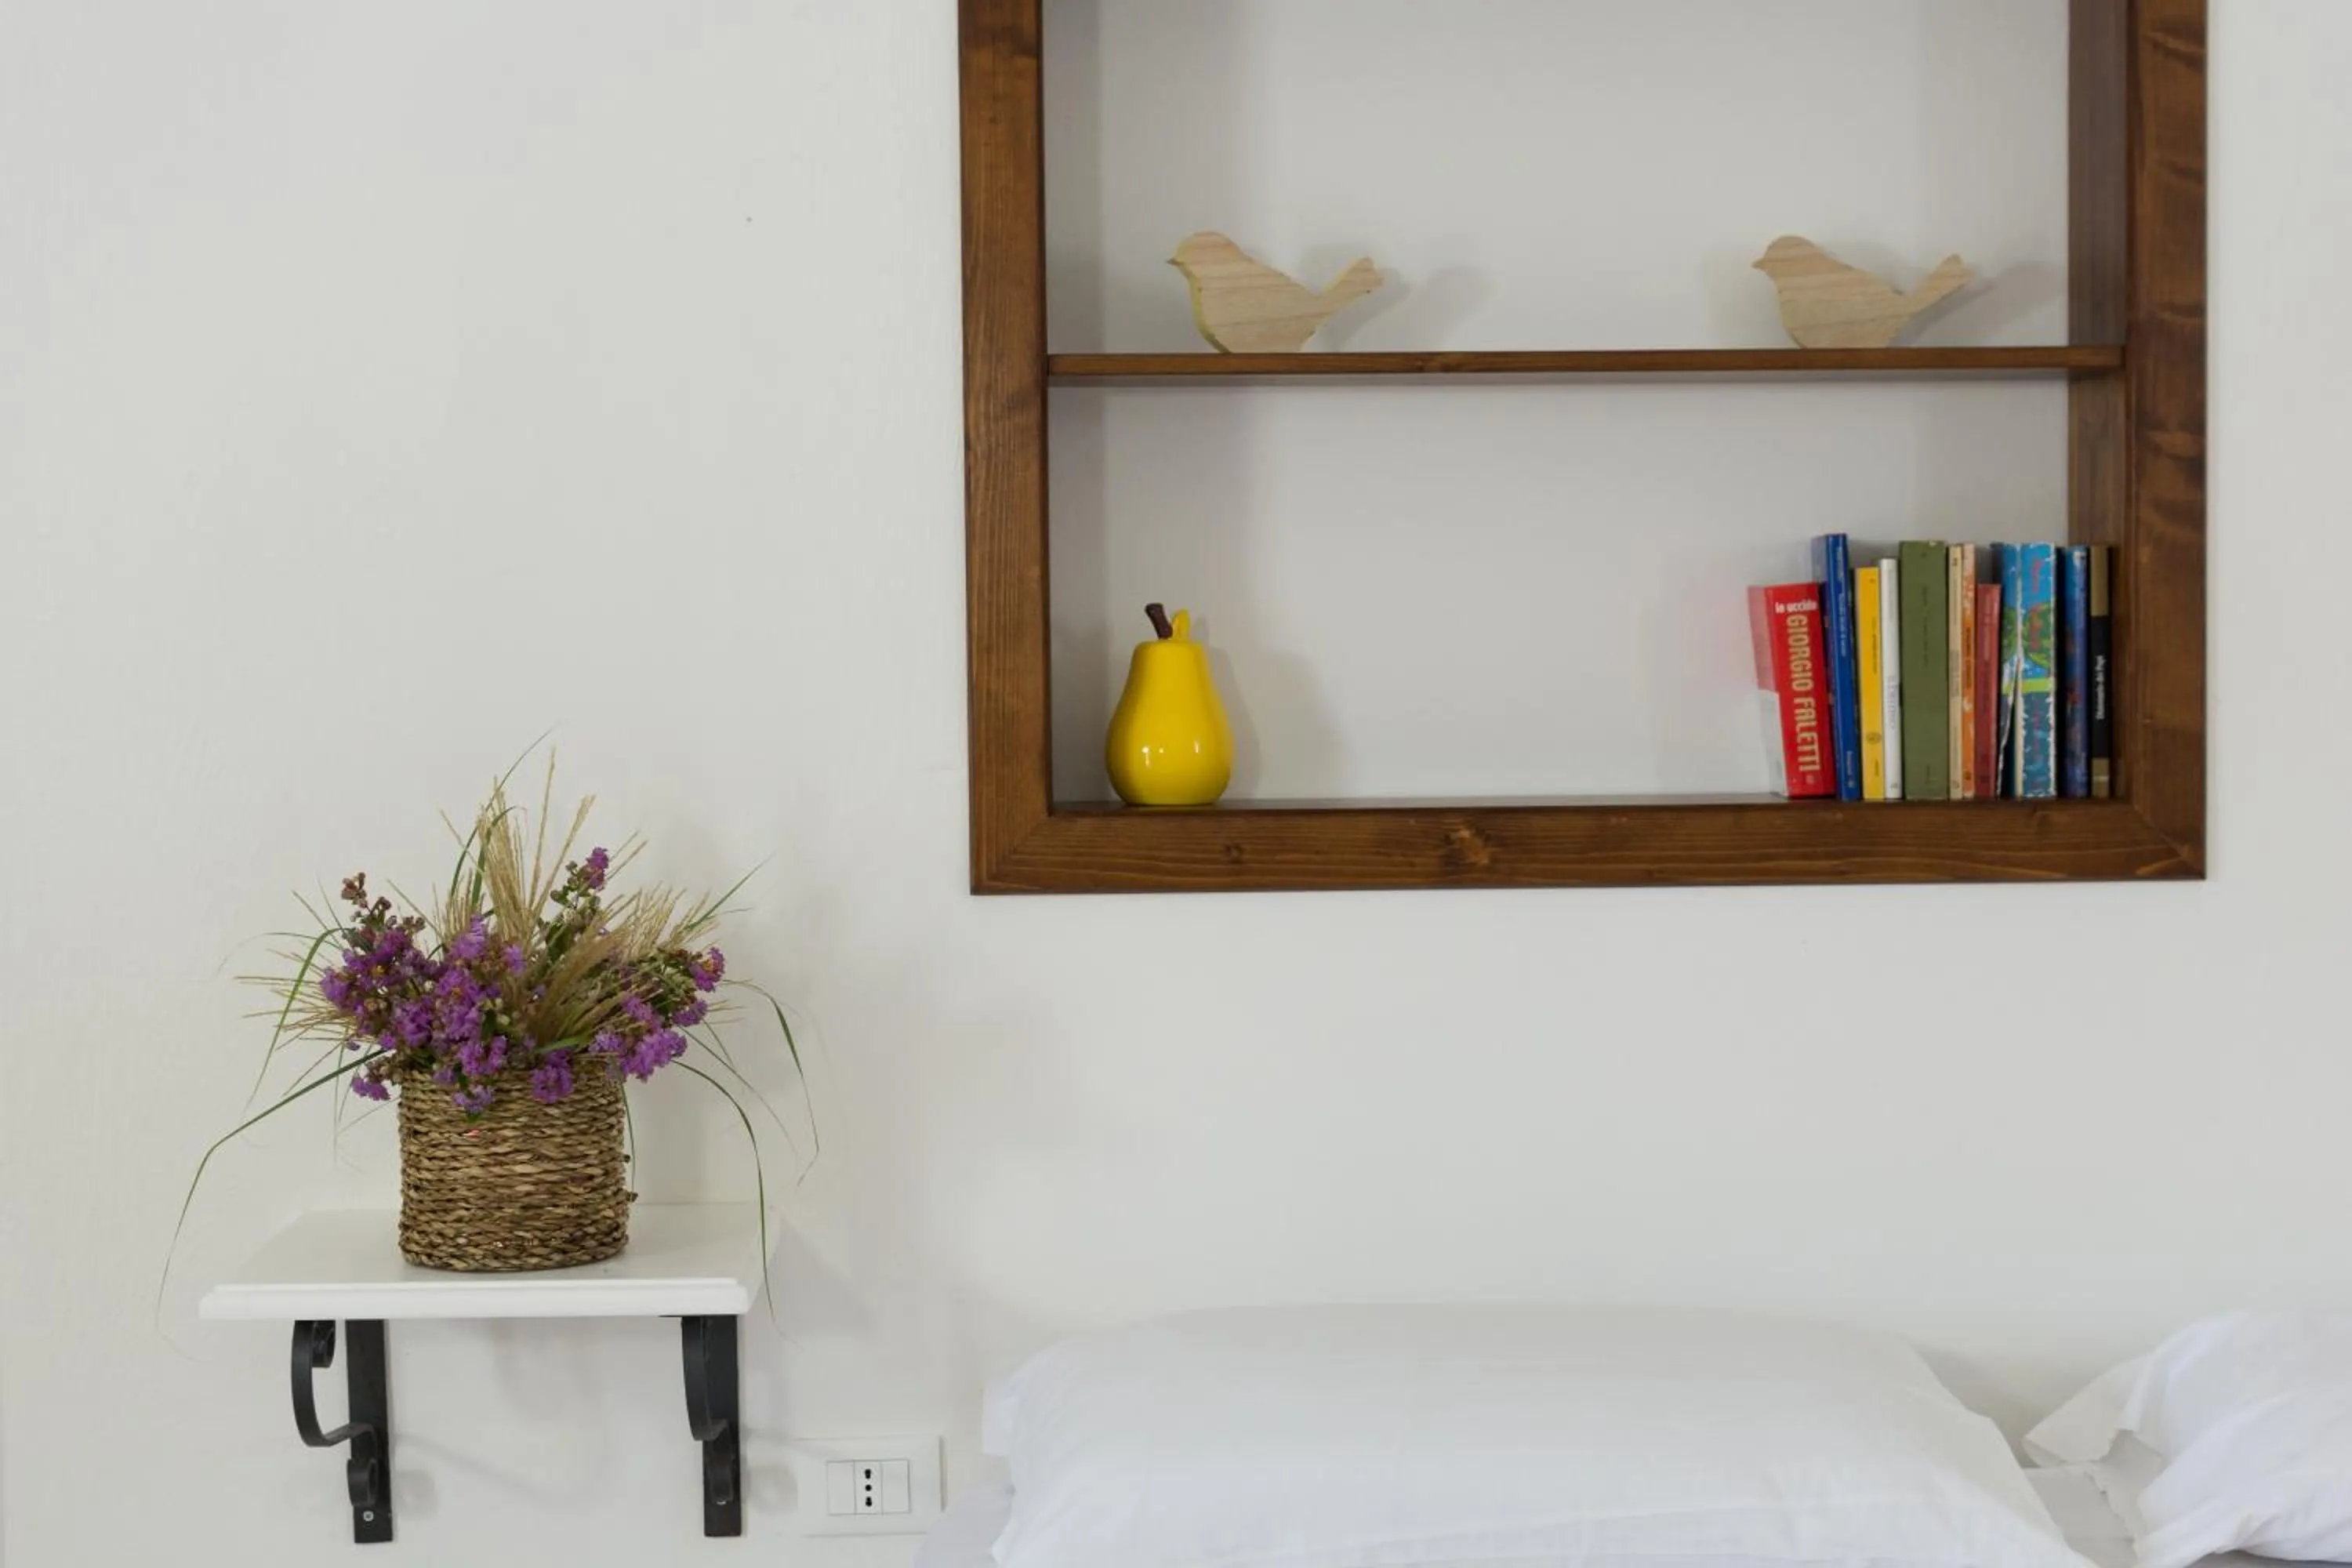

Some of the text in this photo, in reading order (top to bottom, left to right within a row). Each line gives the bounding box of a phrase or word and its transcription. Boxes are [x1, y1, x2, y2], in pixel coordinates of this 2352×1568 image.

[1786, 598, 1818, 612] uccido
[1786, 613, 1820, 772] GIORGIO FALETTI
